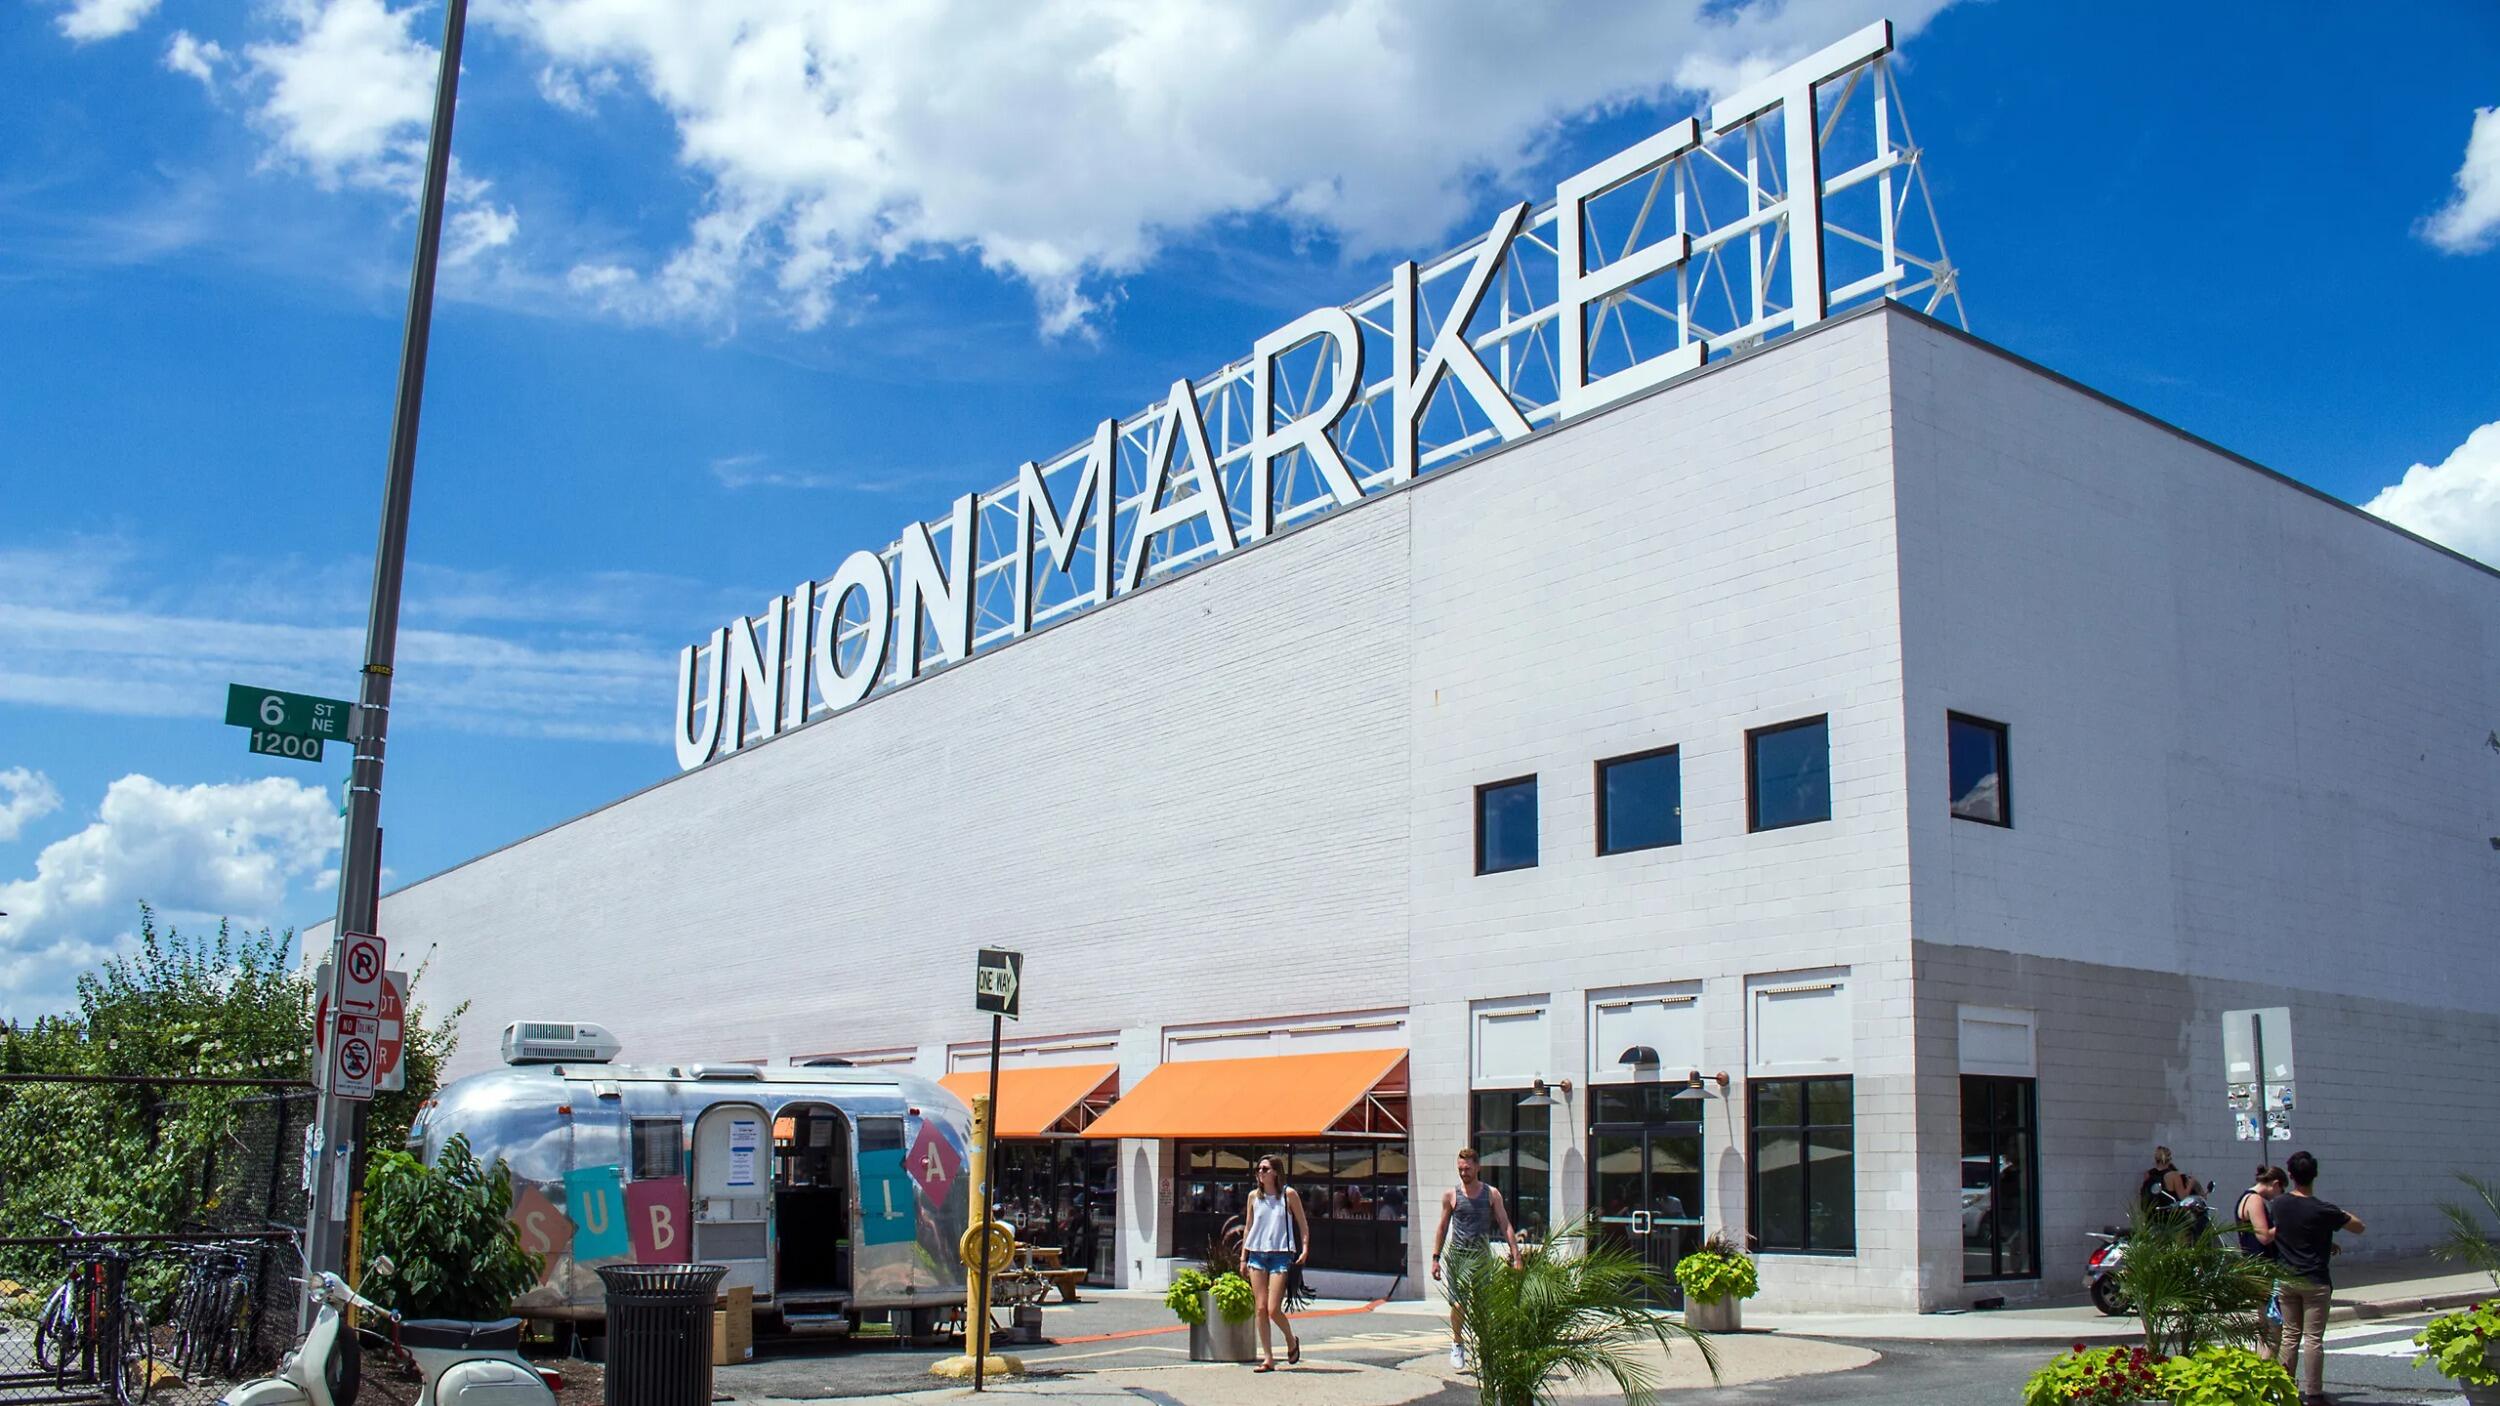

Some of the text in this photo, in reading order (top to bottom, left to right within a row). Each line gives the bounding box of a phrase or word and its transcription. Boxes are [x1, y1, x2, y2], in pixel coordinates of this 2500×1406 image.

[675, 18, 1894, 772] UNION MARKET
[260, 695, 285, 727] 6
[314, 703, 335, 716] ST
[312, 718, 334, 732] NE
[253, 731, 319, 758] 1200
[356, 953, 372, 974] P
[980, 970, 1012, 993] ONE WAY
[342, 1019, 353, 1032] NO
